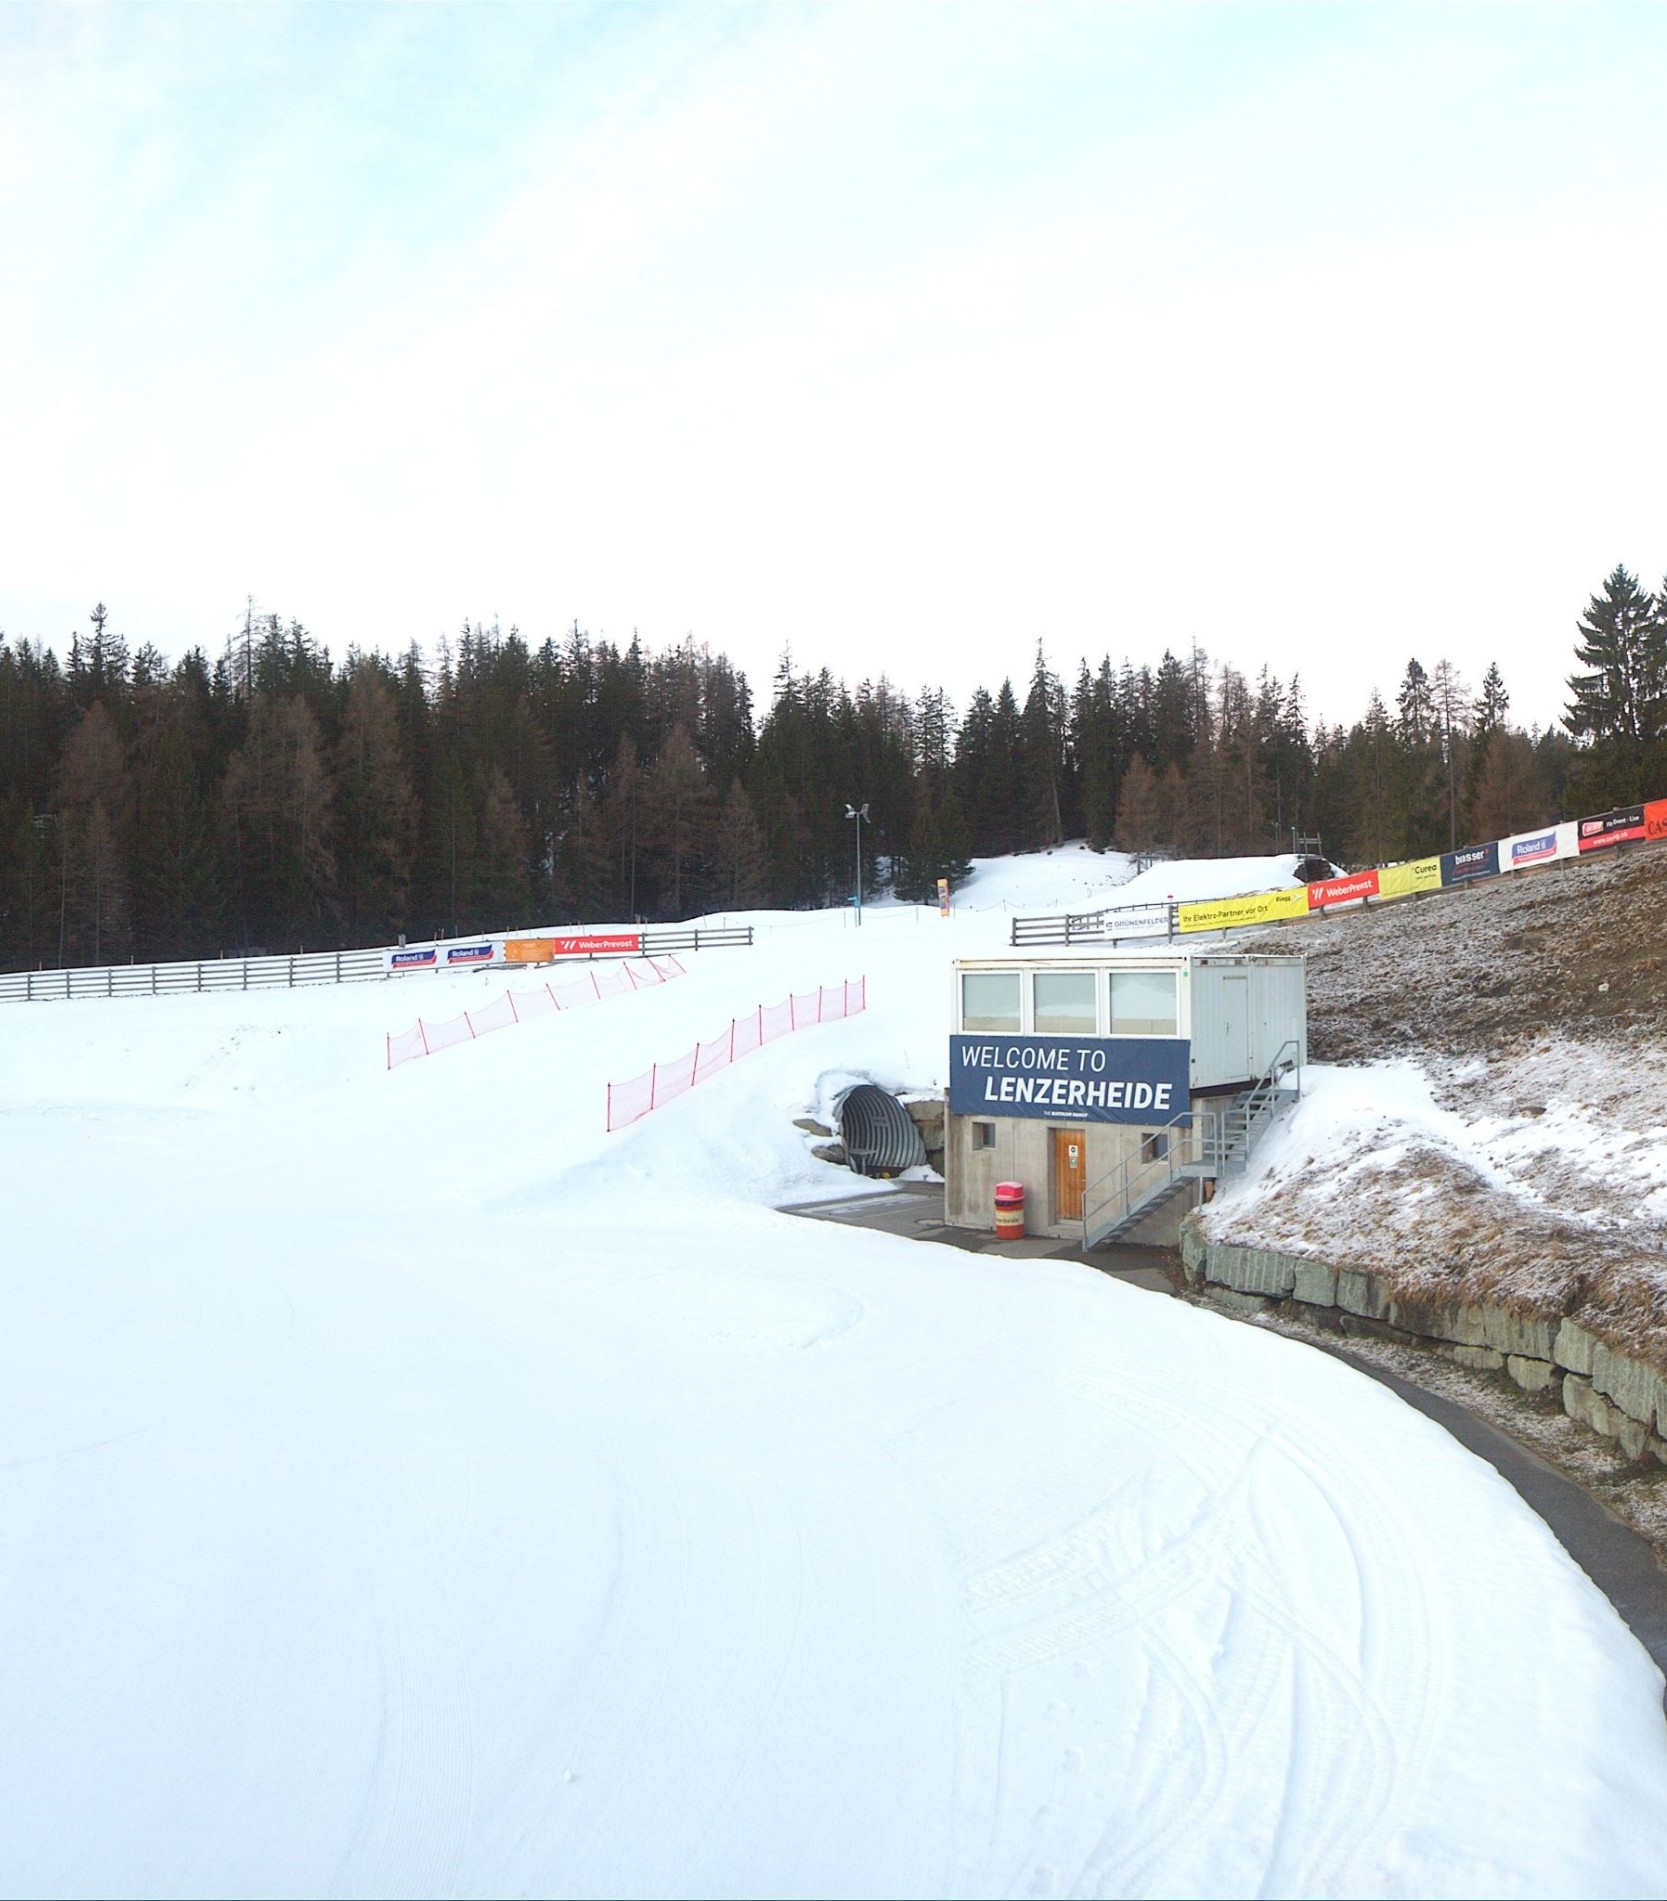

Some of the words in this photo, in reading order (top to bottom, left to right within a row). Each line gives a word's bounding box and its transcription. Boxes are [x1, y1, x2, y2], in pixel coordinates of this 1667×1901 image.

[1517, 843, 1540, 854] Roland
[1455, 850, 1485, 865] brasser
[1183, 913, 1193, 923] Ihr
[1193, 908, 1244, 922] Elektro-Partner
[1245, 907, 1257, 915] vor
[1257, 905, 1269, 914] Ort
[578, 939, 633, 950] WeberPrevost
[395, 954, 417, 963] Roland
[451, 949, 474, 957] Roland
[961, 1045, 1071, 1071] WELCOME
[1076, 1049, 1106, 1073] TO
[984, 1076, 1173, 1110] LENZERHEIDE
